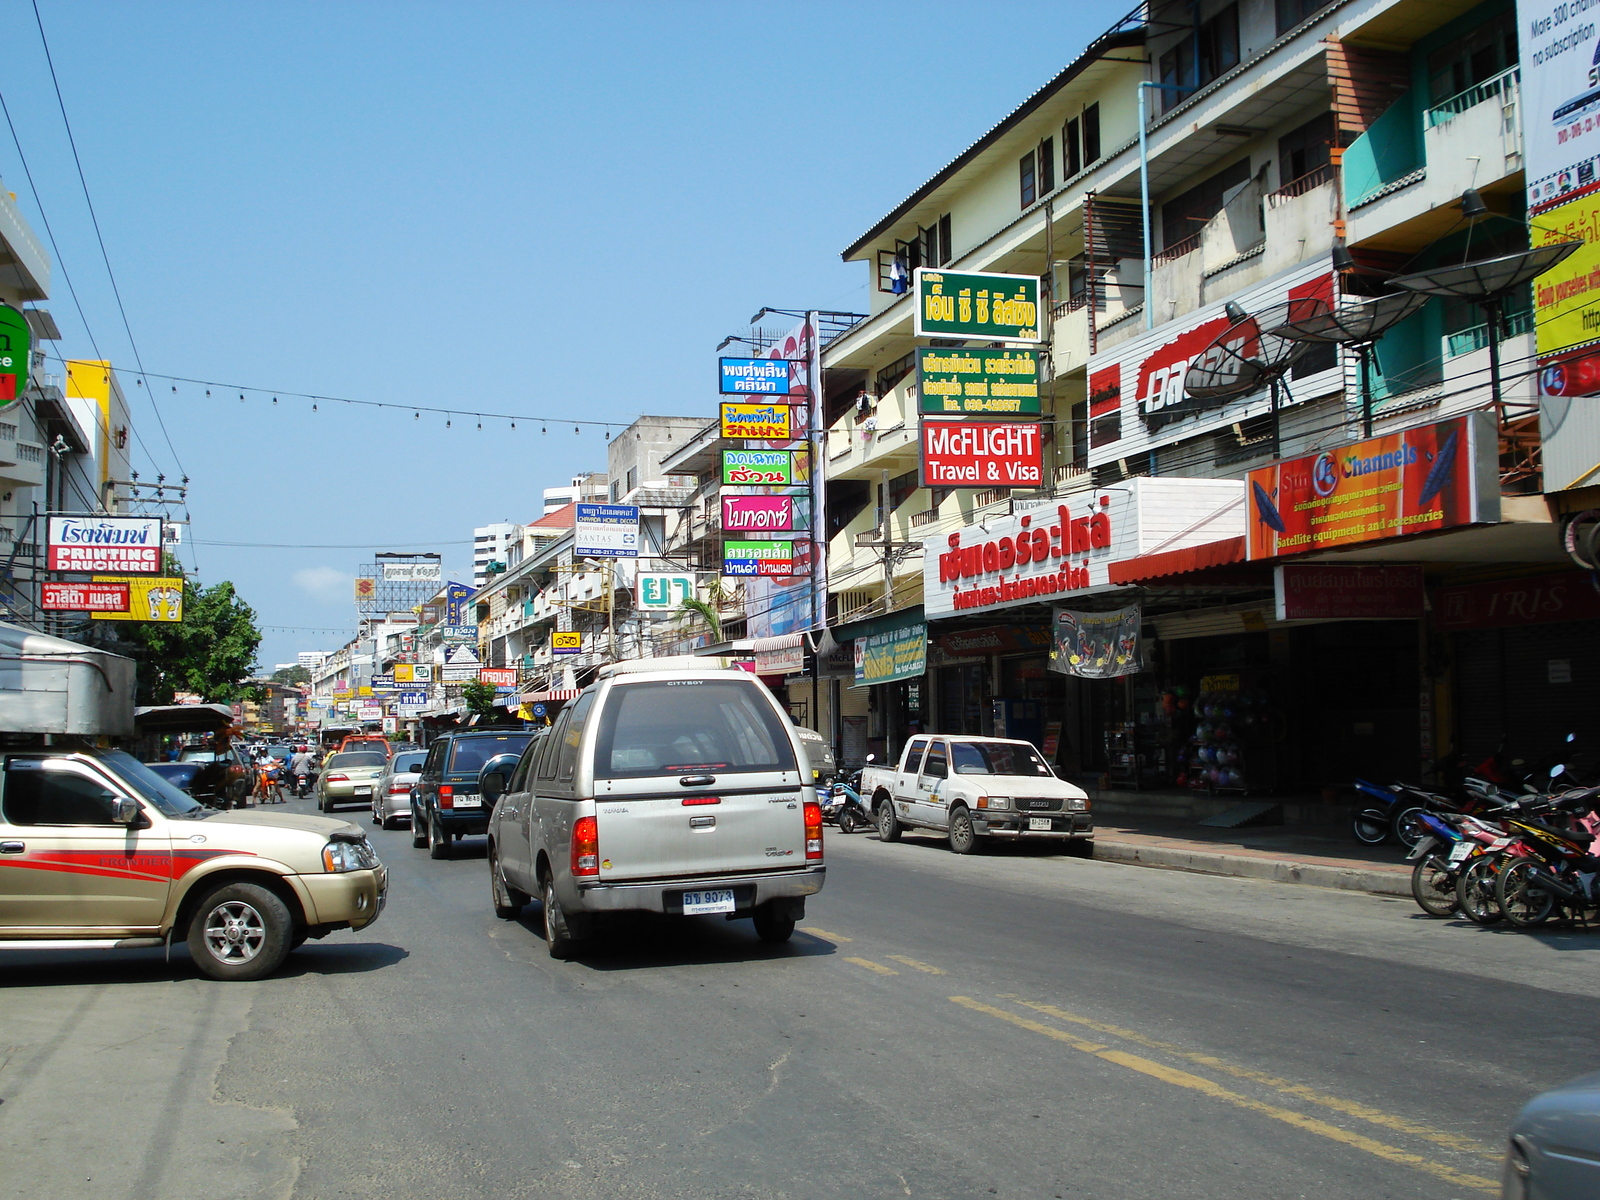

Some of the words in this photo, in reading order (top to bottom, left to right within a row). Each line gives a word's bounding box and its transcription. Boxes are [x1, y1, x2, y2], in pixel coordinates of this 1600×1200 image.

[1531, 16, 1552, 40] More
[1553, 6, 1568, 28] 300
[1532, 52, 1544, 68] no
[1544, 22, 1596, 64] subscription
[925, 283, 954, 322] เอ็น
[734, 376, 776, 392] คลินิก
[928, 428, 1036, 456] McFLIGHT
[725, 453, 787, 466] ลดเฉพาะ
[1281, 469, 1308, 493] Sun
[1341, 443, 1418, 479] Channels
[728, 466, 785, 483] ส่วน
[929, 460, 980, 480] Travel
[987, 461, 999, 480] &
[1005, 461, 1039, 481] Visa
[725, 498, 788, 528] โบทอกซ์
[61, 519, 152, 544] โรงพิมพ์
[1276, 532, 1312, 549] Satellite
[1313, 524, 1365, 541] equipments
[1368, 518, 1386, 531] and
[1387, 508, 1444, 528] accessories
[578, 534, 612, 543] SANTAS
[56, 548, 155, 560] PRINTING
[727, 543, 791, 559] ลบรอยสัก
[56, 560, 155, 571] DRUCKEREI
[725, 560, 758, 575] ปานดำ
[759, 561, 792, 575] ปานแดง
[1488, 586, 1567, 620] IRIS
[100, 857, 171, 866] FRONTIER
[705, 890, 732, 904] 9073
